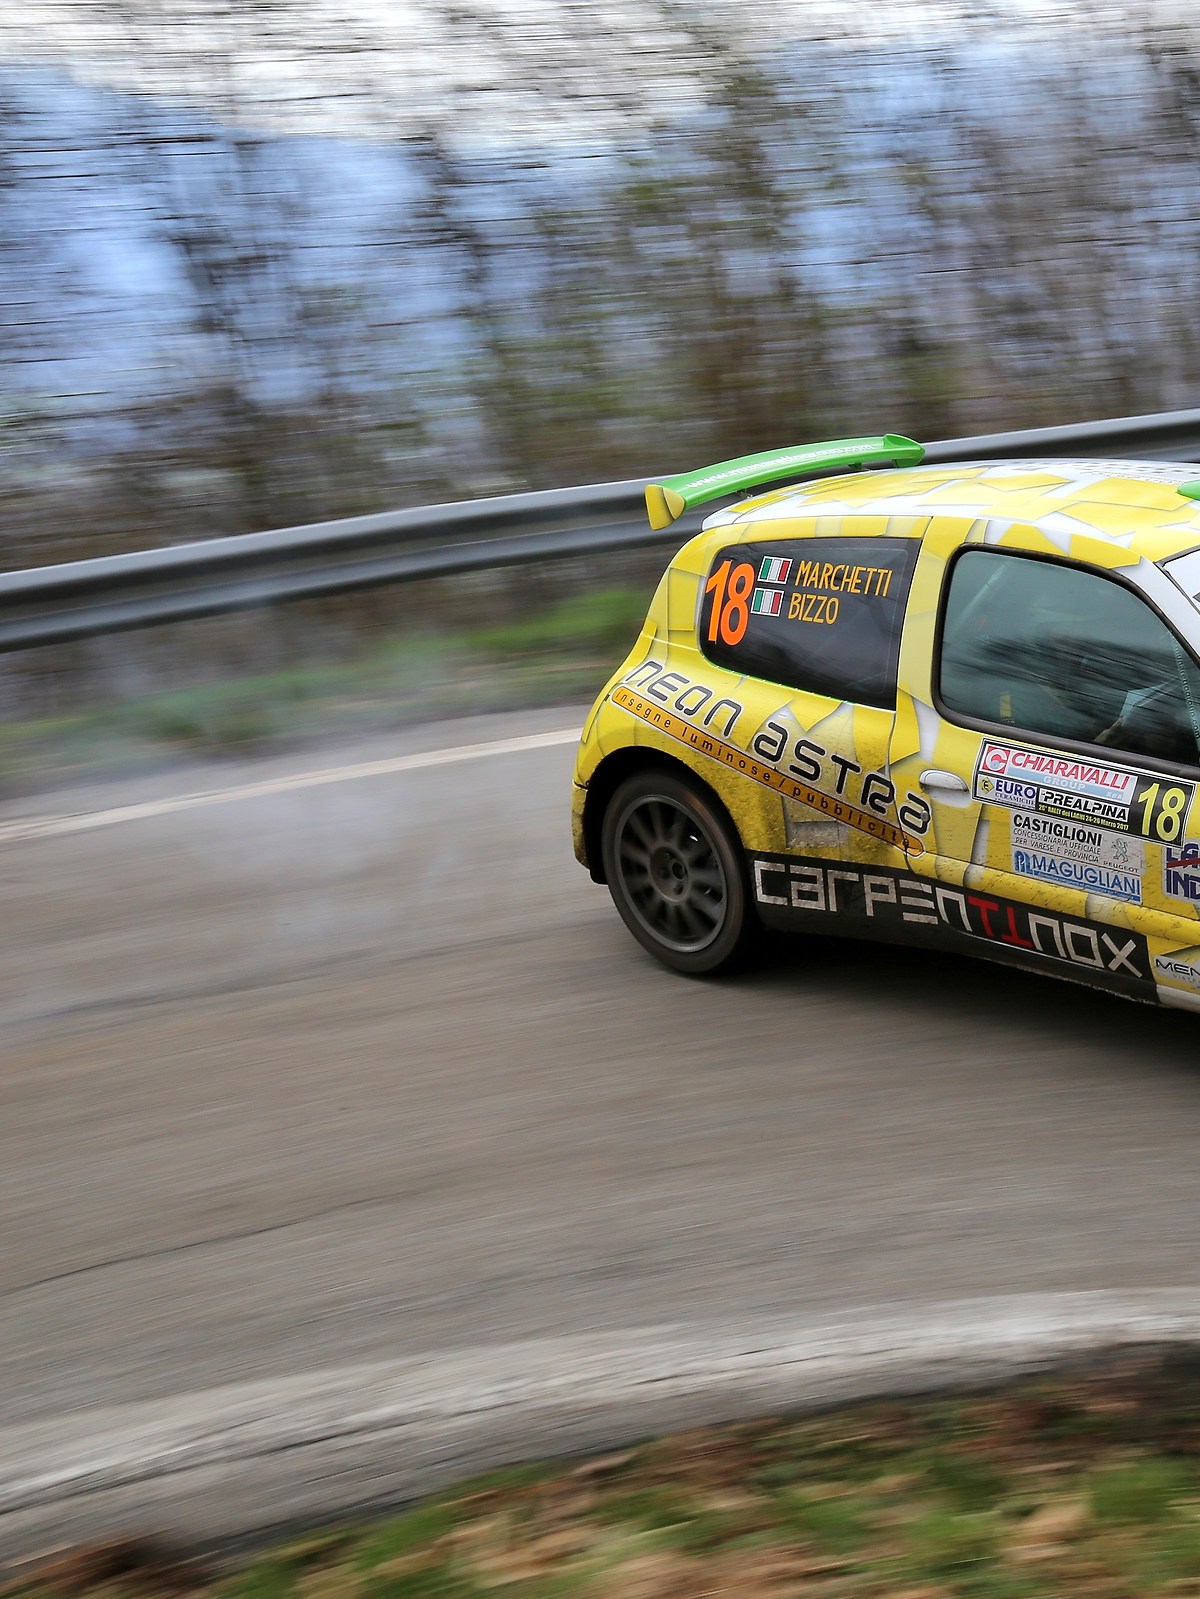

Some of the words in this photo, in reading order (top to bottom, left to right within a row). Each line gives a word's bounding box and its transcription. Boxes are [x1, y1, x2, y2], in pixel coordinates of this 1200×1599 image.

[795, 560, 893, 597] MARCHETTI
[705, 559, 755, 646] 18
[788, 593, 839, 624] BIZZO
[615, 690, 671, 728] insegne
[625, 661, 743, 737] NEON
[754, 721, 931, 834] ASTRA
[1011, 752, 1130, 790] CHIARAVALLI
[1043, 776, 1086, 790] GROUP
[995, 780, 1036, 799] EURO
[1044, 791, 1127, 820] PREALPINA
[1116, 822, 1129, 831] 2017
[1138, 782, 1186, 842] 18
[1013, 814, 1102, 847] CASTIGLIONI
[1013, 828, 1069, 846] CONCESSIONARIA
[1069, 841, 1101, 856] UFFICIALE
[1015, 837, 1028, 846] PER
[1031, 841, 1054, 853] VARESE
[1063, 848, 1099, 863] PROVINCIA
[1031, 853, 1140, 895] MAGUGLIANI
[1103, 860, 1139, 873] PEUGEOT
